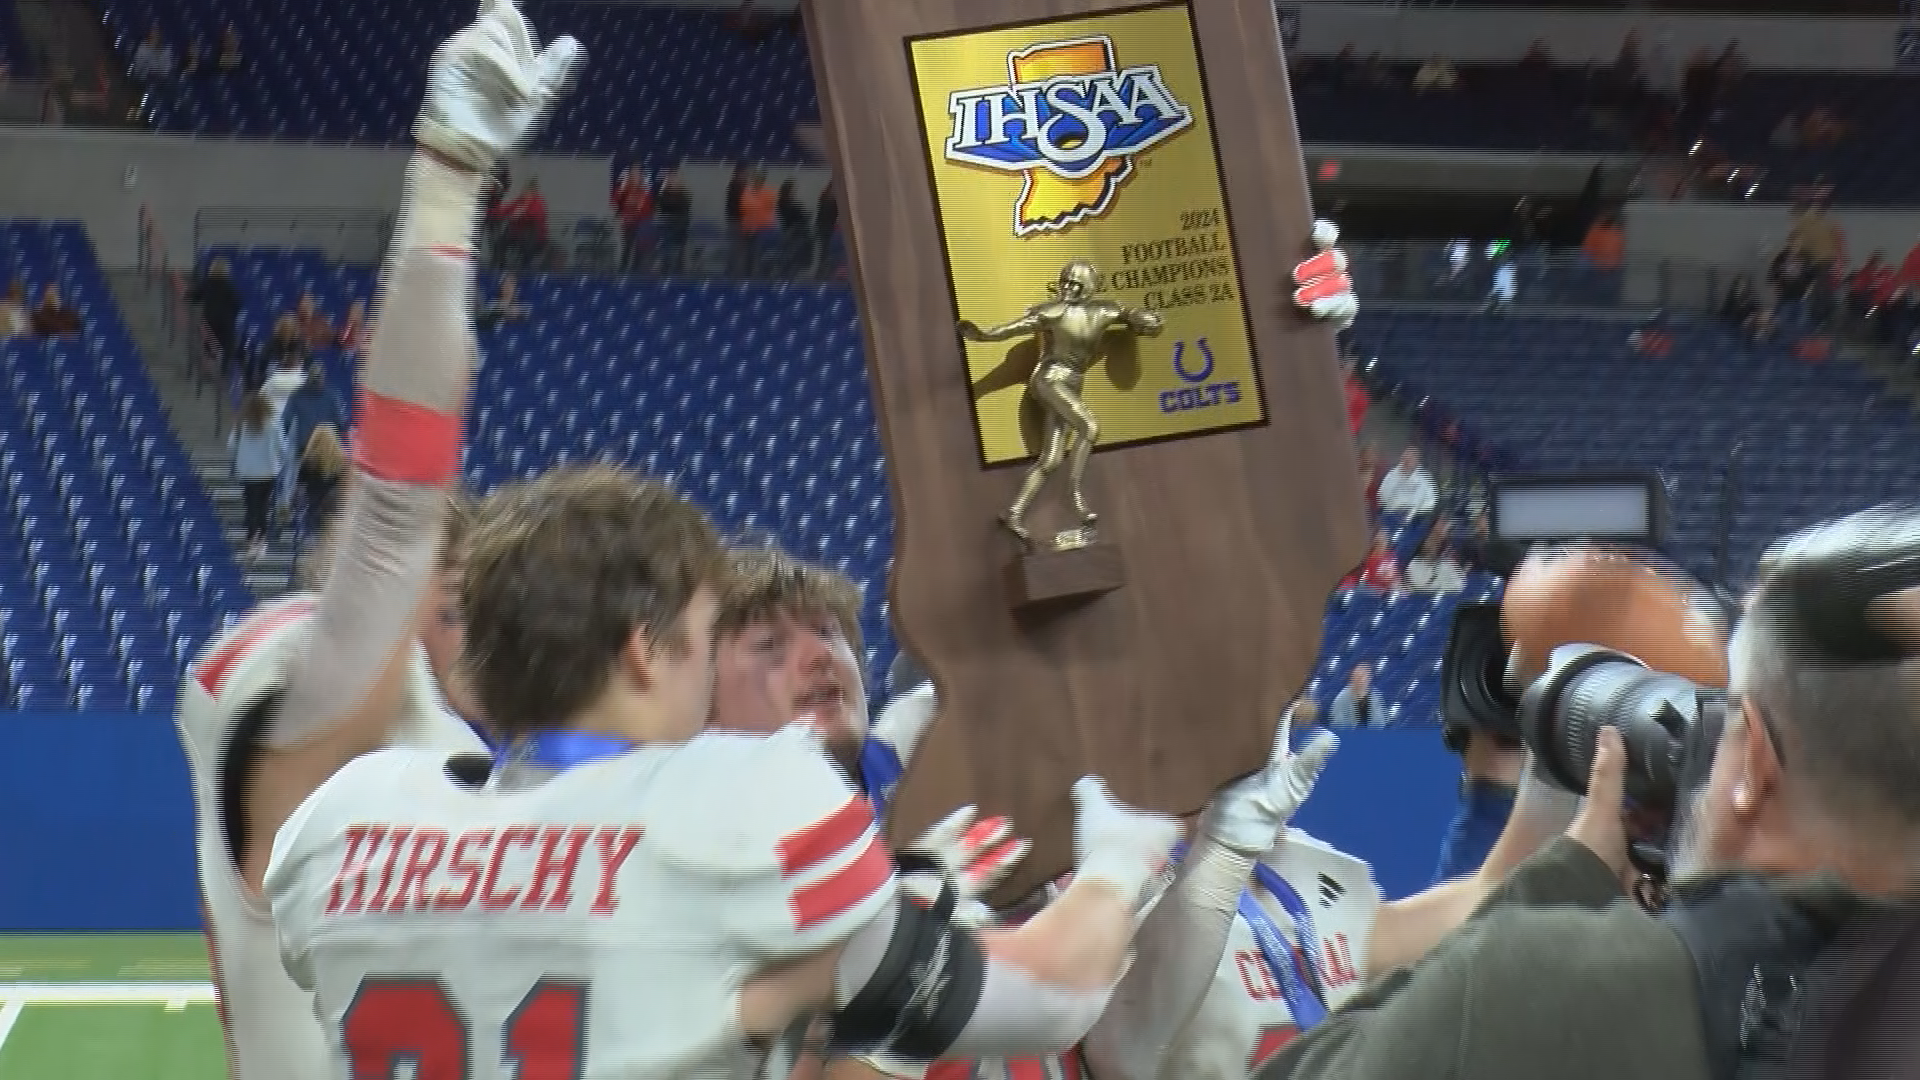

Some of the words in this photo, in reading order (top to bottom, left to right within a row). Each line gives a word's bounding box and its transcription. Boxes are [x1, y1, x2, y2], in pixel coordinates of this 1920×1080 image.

[950, 70, 1181, 164] IHSAA
[1181, 208, 1220, 231] 2024
[1122, 233, 1227, 264] FOOTBALL
[1112, 257, 1229, 290] CHAMPIONS
[1144, 289, 1207, 311] CLASS
[1211, 283, 1235, 301] 2A
[1158, 382, 1242, 414] COLTS
[325, 822, 646, 917] HIRSCHY
